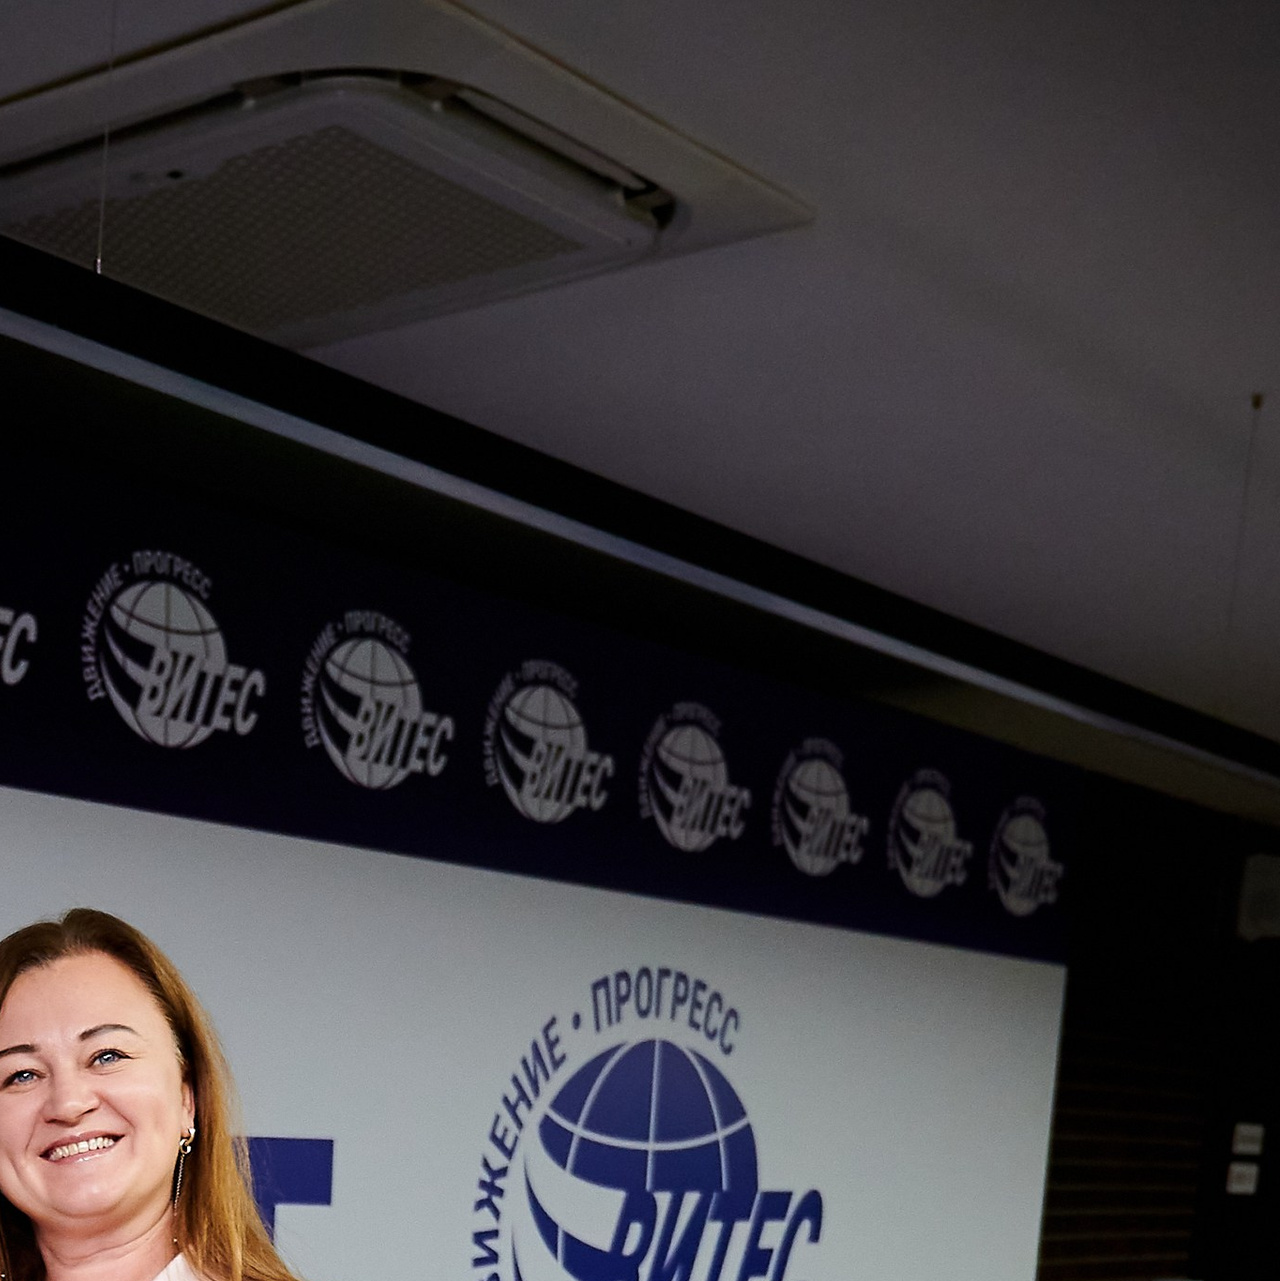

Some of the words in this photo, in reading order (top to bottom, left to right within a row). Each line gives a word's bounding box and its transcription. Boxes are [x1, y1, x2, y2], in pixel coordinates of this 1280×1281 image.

[135, 647, 267, 737] ВИТЕС
[346, 699, 456, 777] ВИТЕС
[590, 966, 742, 1057] ПРОГРЕСС
